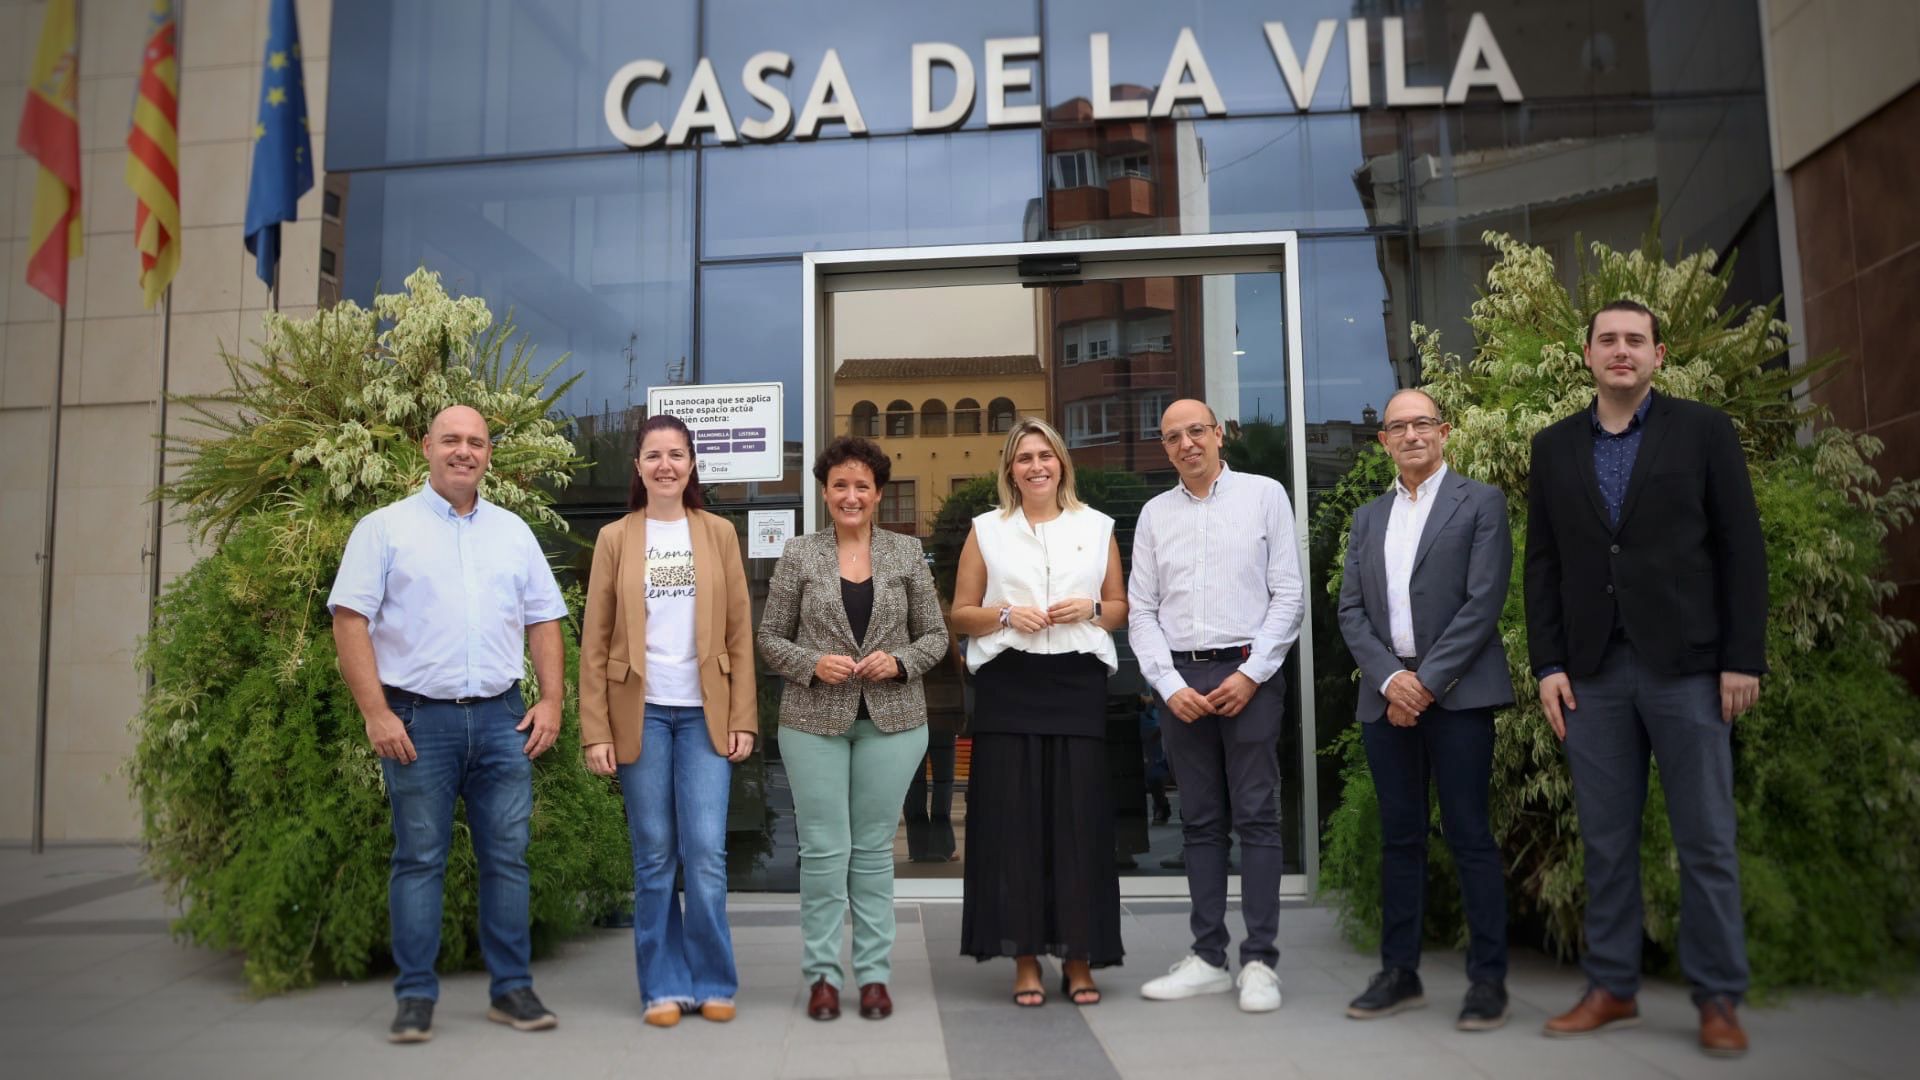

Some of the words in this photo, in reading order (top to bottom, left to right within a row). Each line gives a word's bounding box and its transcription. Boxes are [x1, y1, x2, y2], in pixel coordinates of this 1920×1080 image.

[604, 48, 867, 149] CASA
[911, 36, 1042, 133] DE
[1090, 27, 1226, 119] LA
[1263, 12, 1523, 114] VILA
[675, 398, 715, 406] nanocapa
[717, 397, 733, 405] que
[746, 394, 771, 404] aplica
[696, 405, 728, 414] espacio
[730, 404, 754, 412] actúa
[700, 415, 730, 423] contra:
[645, 546, 692, 566] trong
